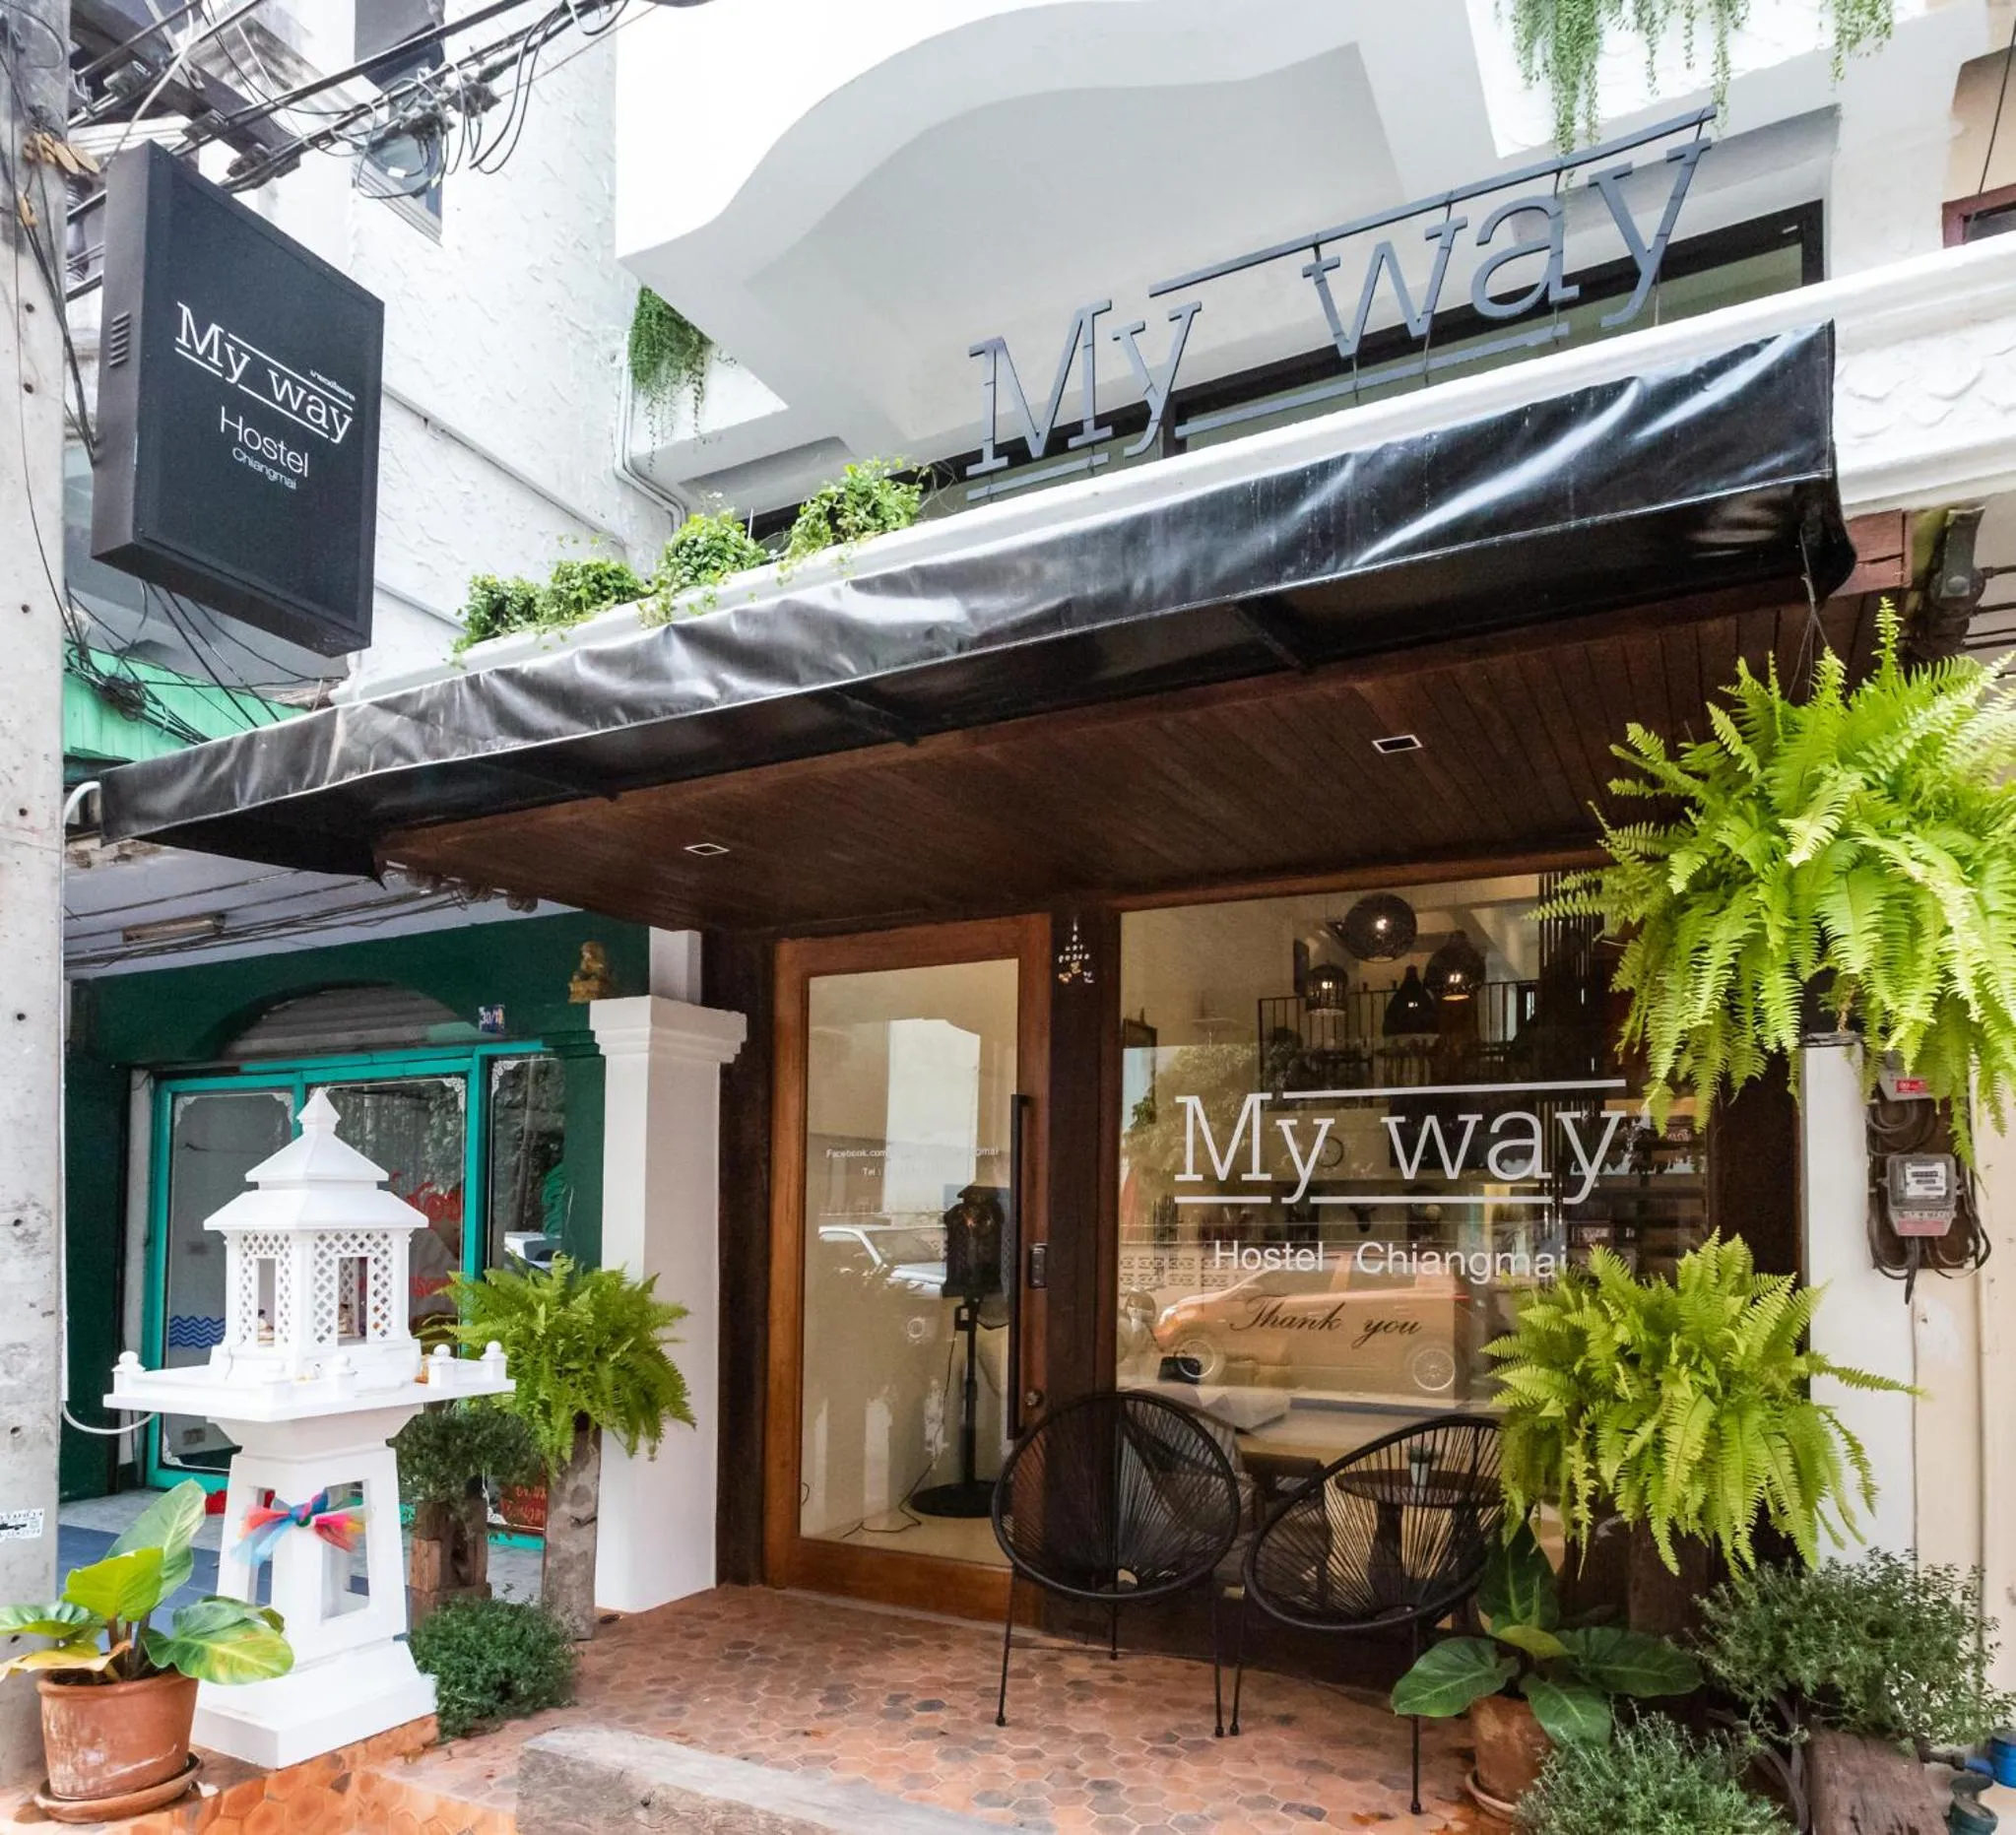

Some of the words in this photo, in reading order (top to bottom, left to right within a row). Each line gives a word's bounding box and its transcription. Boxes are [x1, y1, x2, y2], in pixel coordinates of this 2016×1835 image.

[965, 297, 1203, 478] My
[1302, 138, 1712, 359] way
[174, 300, 251, 384] My
[267, 368, 353, 444] way
[220, 405, 309, 478] Hostel
[231, 446, 297, 491] Chiangmai
[1174, 1092, 1335, 1205] My
[1380, 1110, 1627, 1205] way
[1213, 1241, 1324, 1272] Hostel
[1355, 1241, 1568, 1285] Chiangmai
[1229, 1292, 1346, 1334] Thank
[1352, 1317, 1422, 1349] you
